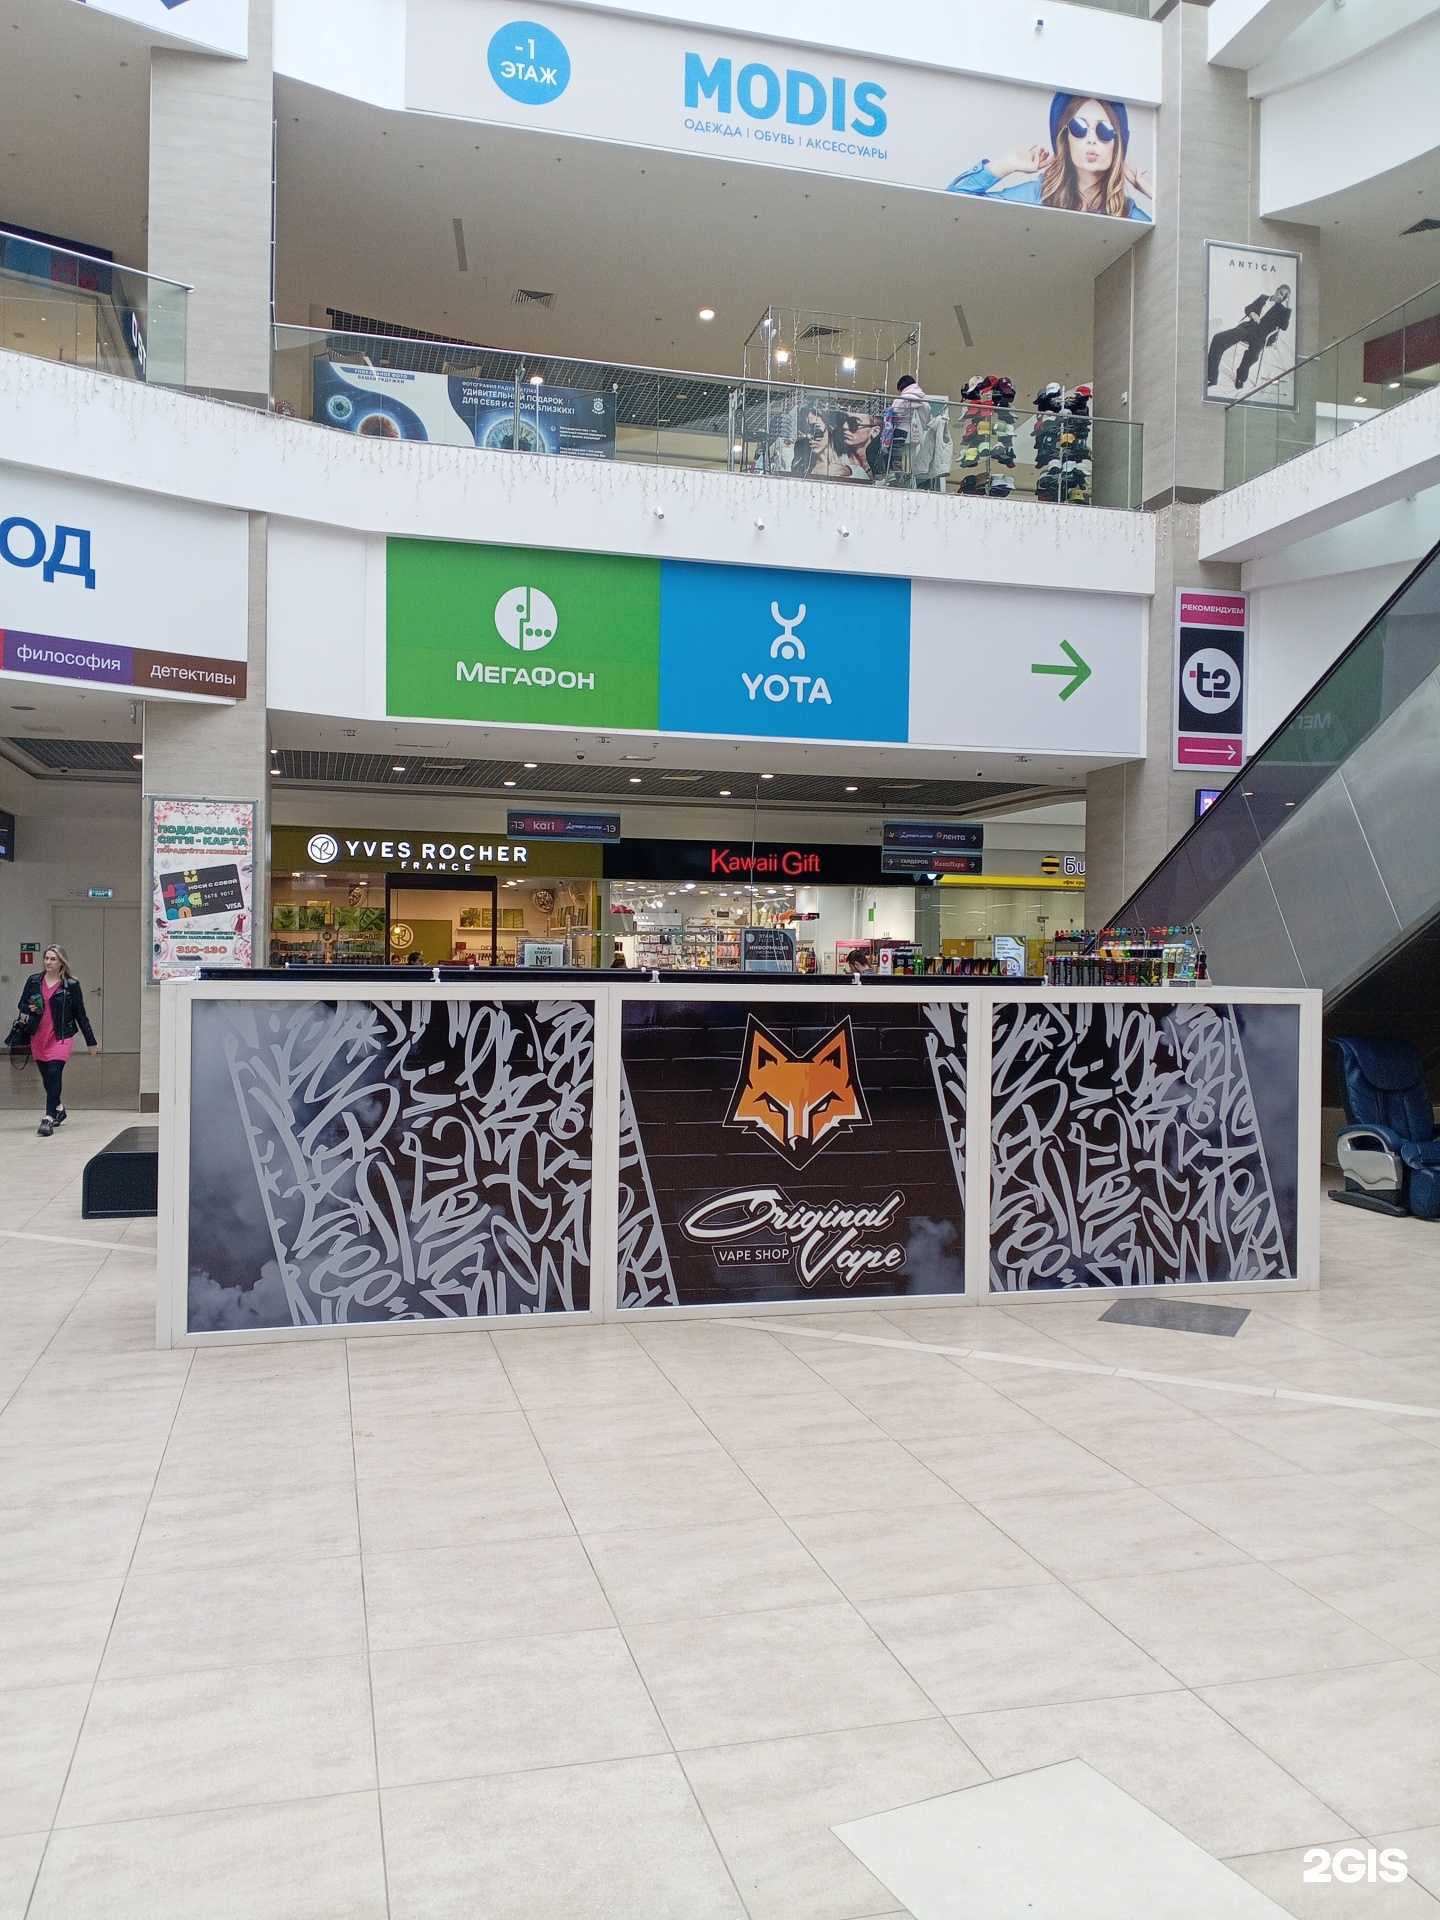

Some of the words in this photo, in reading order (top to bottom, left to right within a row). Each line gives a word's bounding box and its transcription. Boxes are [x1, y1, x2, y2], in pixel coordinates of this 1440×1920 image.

[514, 38, 536, 60] -1
[500, 61, 559, 86] ЭТАЖ
[684, 51, 888, 138] MODIS
[684, 117, 743, 138] ОДЕЖДА
[753, 129, 796, 146] ОБУВЬ
[805, 137, 889, 161] АКСЕССУАРЫ
[462, 387, 526, 402] УДИВИТЕЛЬНЙ
[526, 394, 564, 407] ПОДАРОК
[462, 396, 479, 406] ДЛЯ
[479, 398, 501, 408] СЕБЯ
[508, 401, 536, 411] СОИХ
[1181, 603, 1245, 615] РЕКОМЕНДУЕМ
[16, 644, 121, 671] философия
[150, 664, 236, 686] детективы
[1190, 662, 1232, 699] t2
[741, 672, 833, 705] YOTA
[157, 824, 249, 837] ПОДАРОЧНАЯ
[533, 820, 556, 831] kari
[345, 840, 412, 859] YVES
[421, 842, 528, 863] ROCHER
[710, 848, 778, 874] Kawaii
[781, 851, 821, 876] Gift
[400, 861, 472, 872] FRANCE
[225, 902, 243, 910] VISA
[684, 1189, 901, 1243] Original
[719, 1250, 752, 1262] VAPE
[754, 1248, 790, 1261] SHOP
[800, 1227, 903, 1283] Vape
